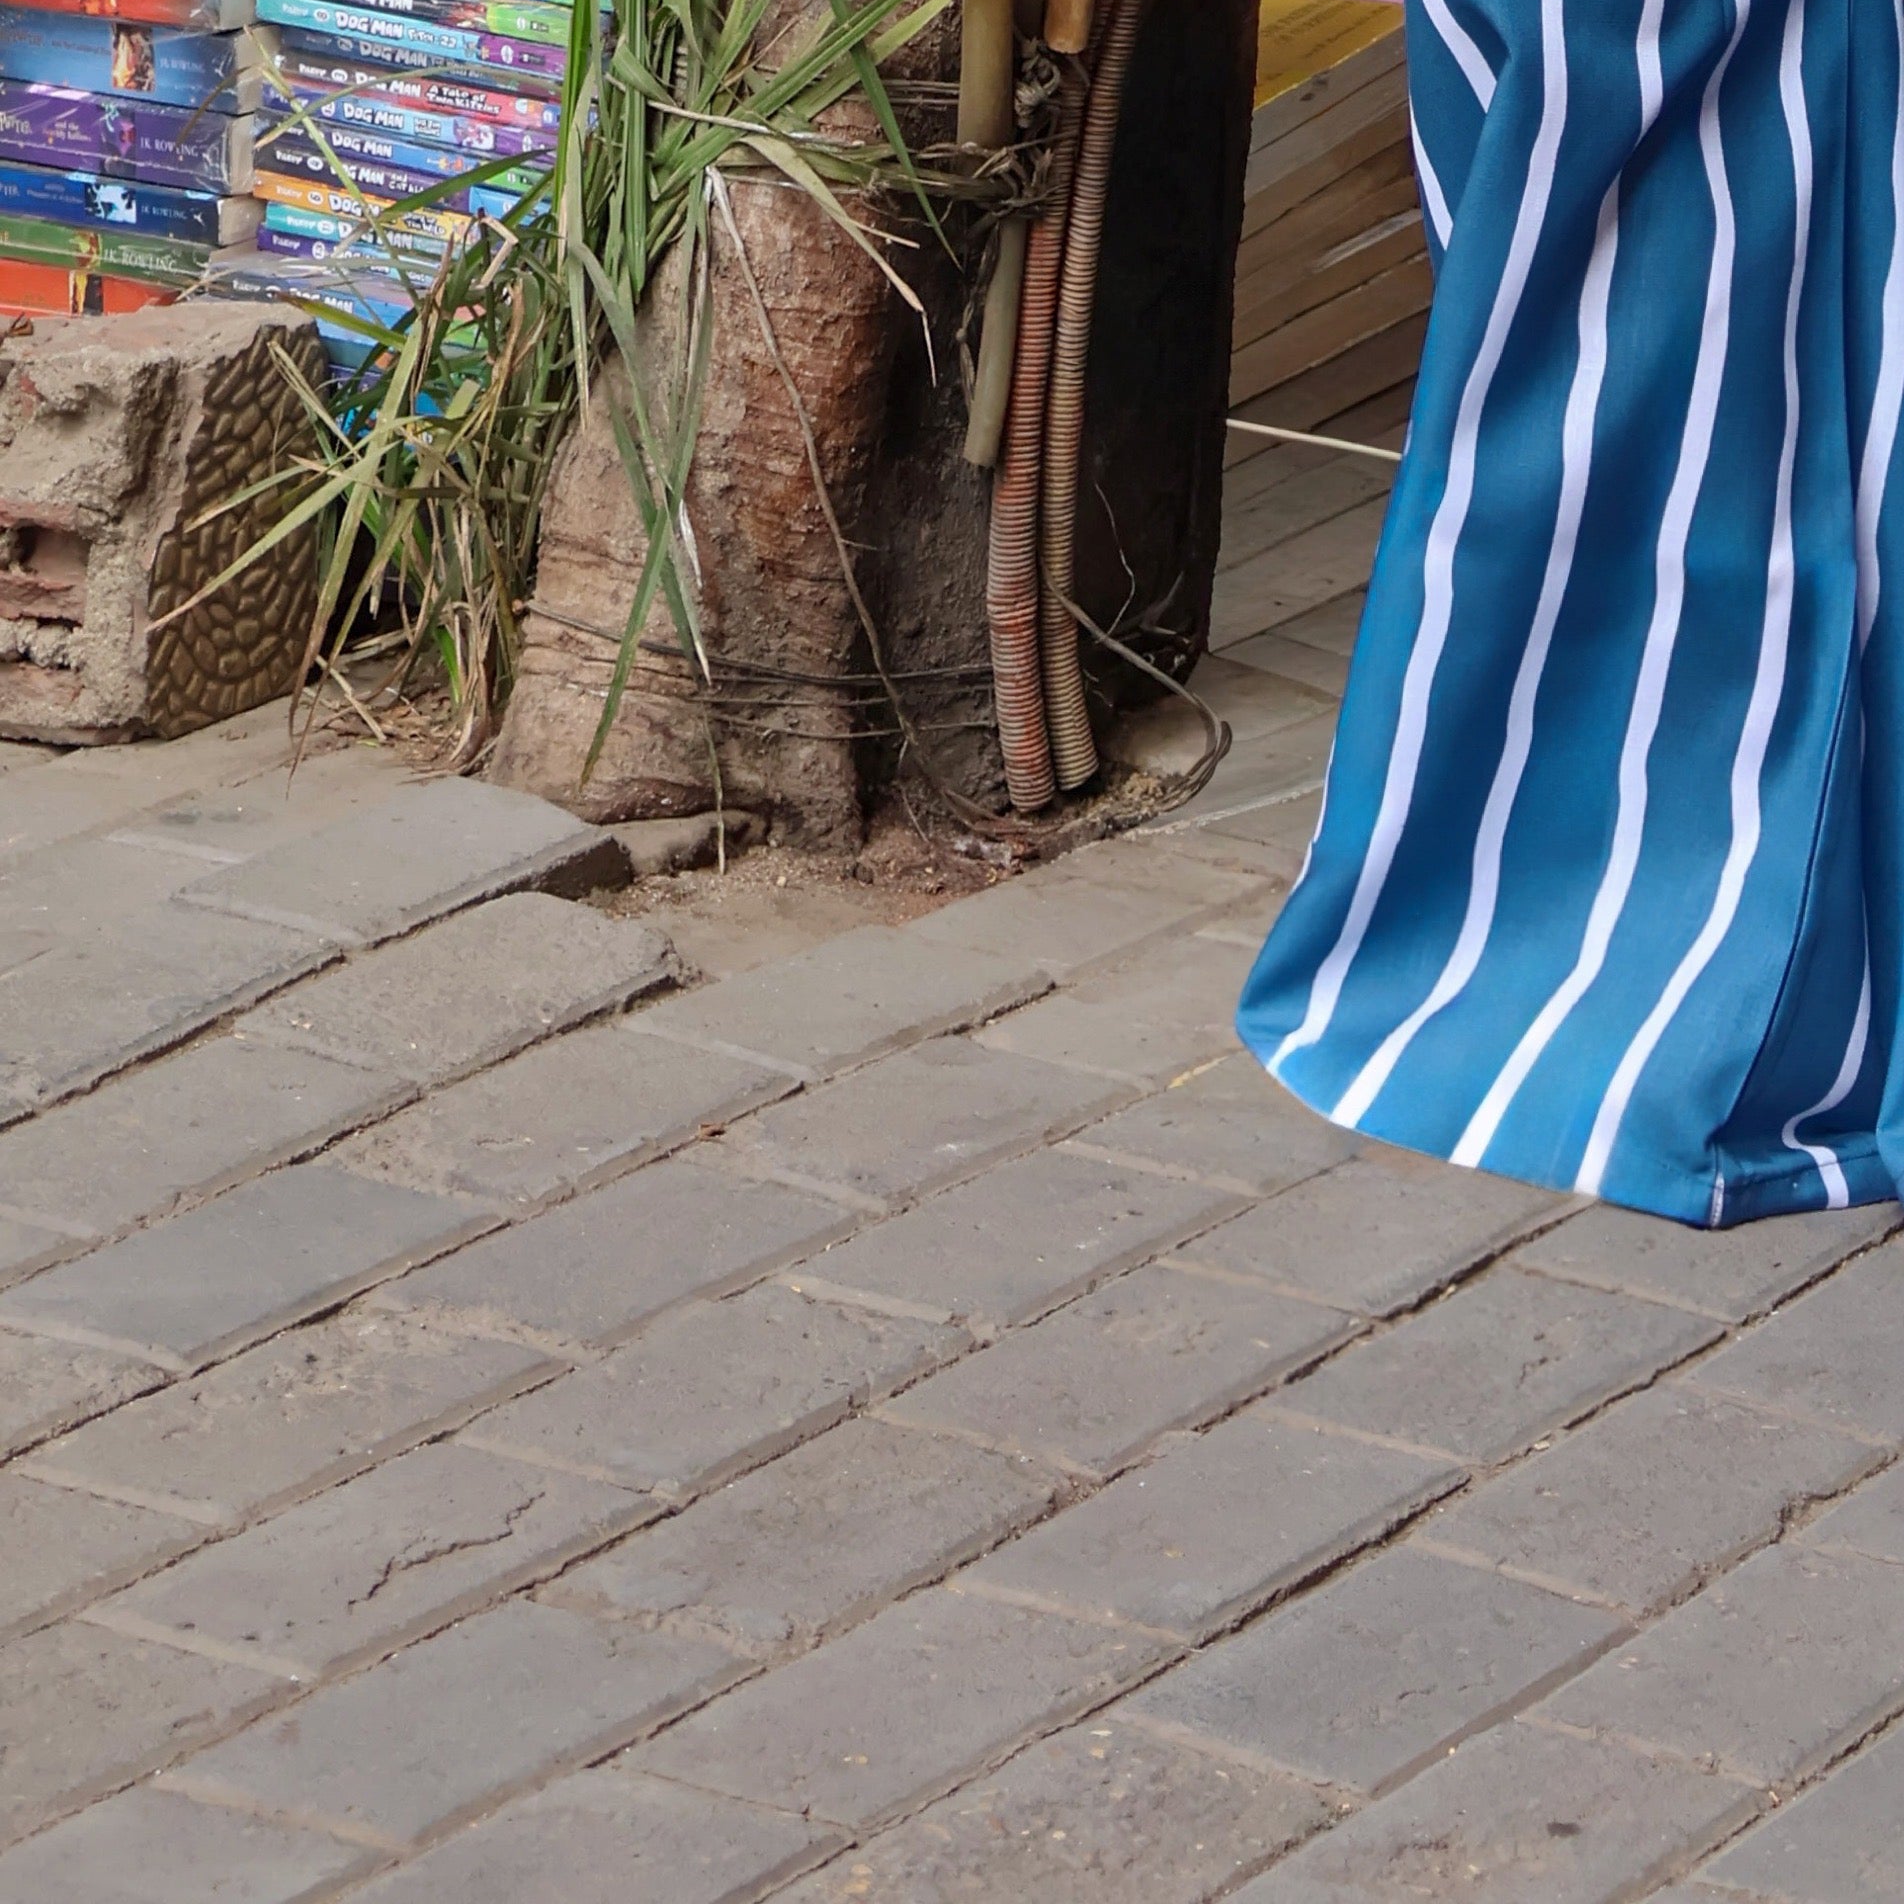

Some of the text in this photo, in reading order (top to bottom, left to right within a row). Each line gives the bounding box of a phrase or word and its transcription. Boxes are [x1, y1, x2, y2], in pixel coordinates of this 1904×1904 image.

[334, 10, 369, 33] DOG
[370, 17, 405, 40] MAN
[359, 39, 429, 68] DOG MAN
[342, 102, 404, 129] DOG MAN
[330, 131, 393, 158] DOG MAN
[357, 168, 385, 187] MAN
